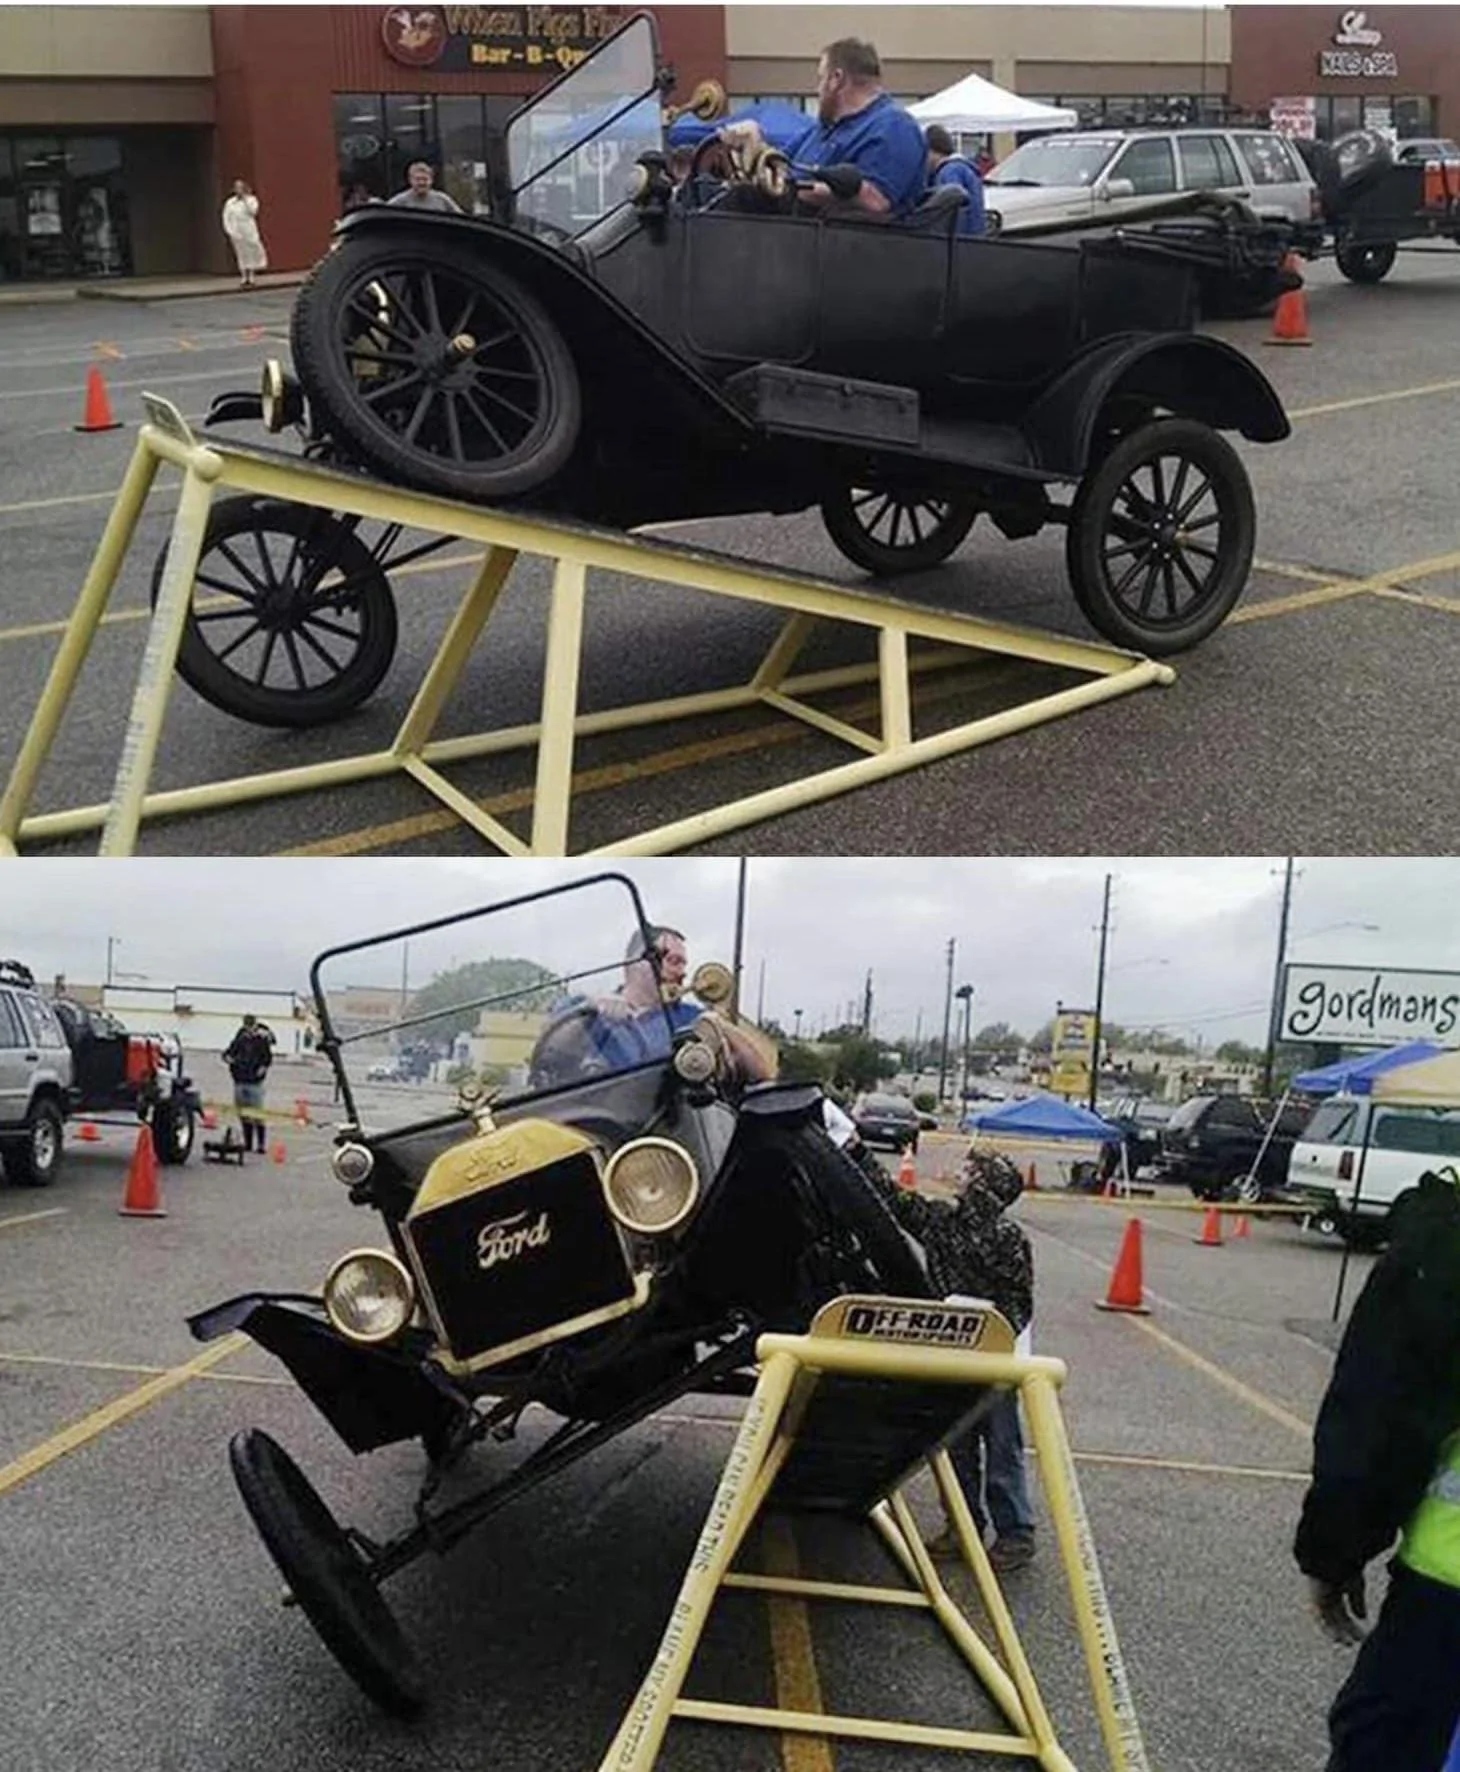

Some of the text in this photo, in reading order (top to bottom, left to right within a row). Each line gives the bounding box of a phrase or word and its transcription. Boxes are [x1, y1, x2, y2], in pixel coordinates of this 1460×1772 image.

[442, 5, 524, 36] When
[527, 5, 580, 44] Pigs
[1287, 974, 1460, 1036] gordmans
[476, 1210, 551, 1269] Ford
[848, 1308, 980, 1333] OFF-ROAD
